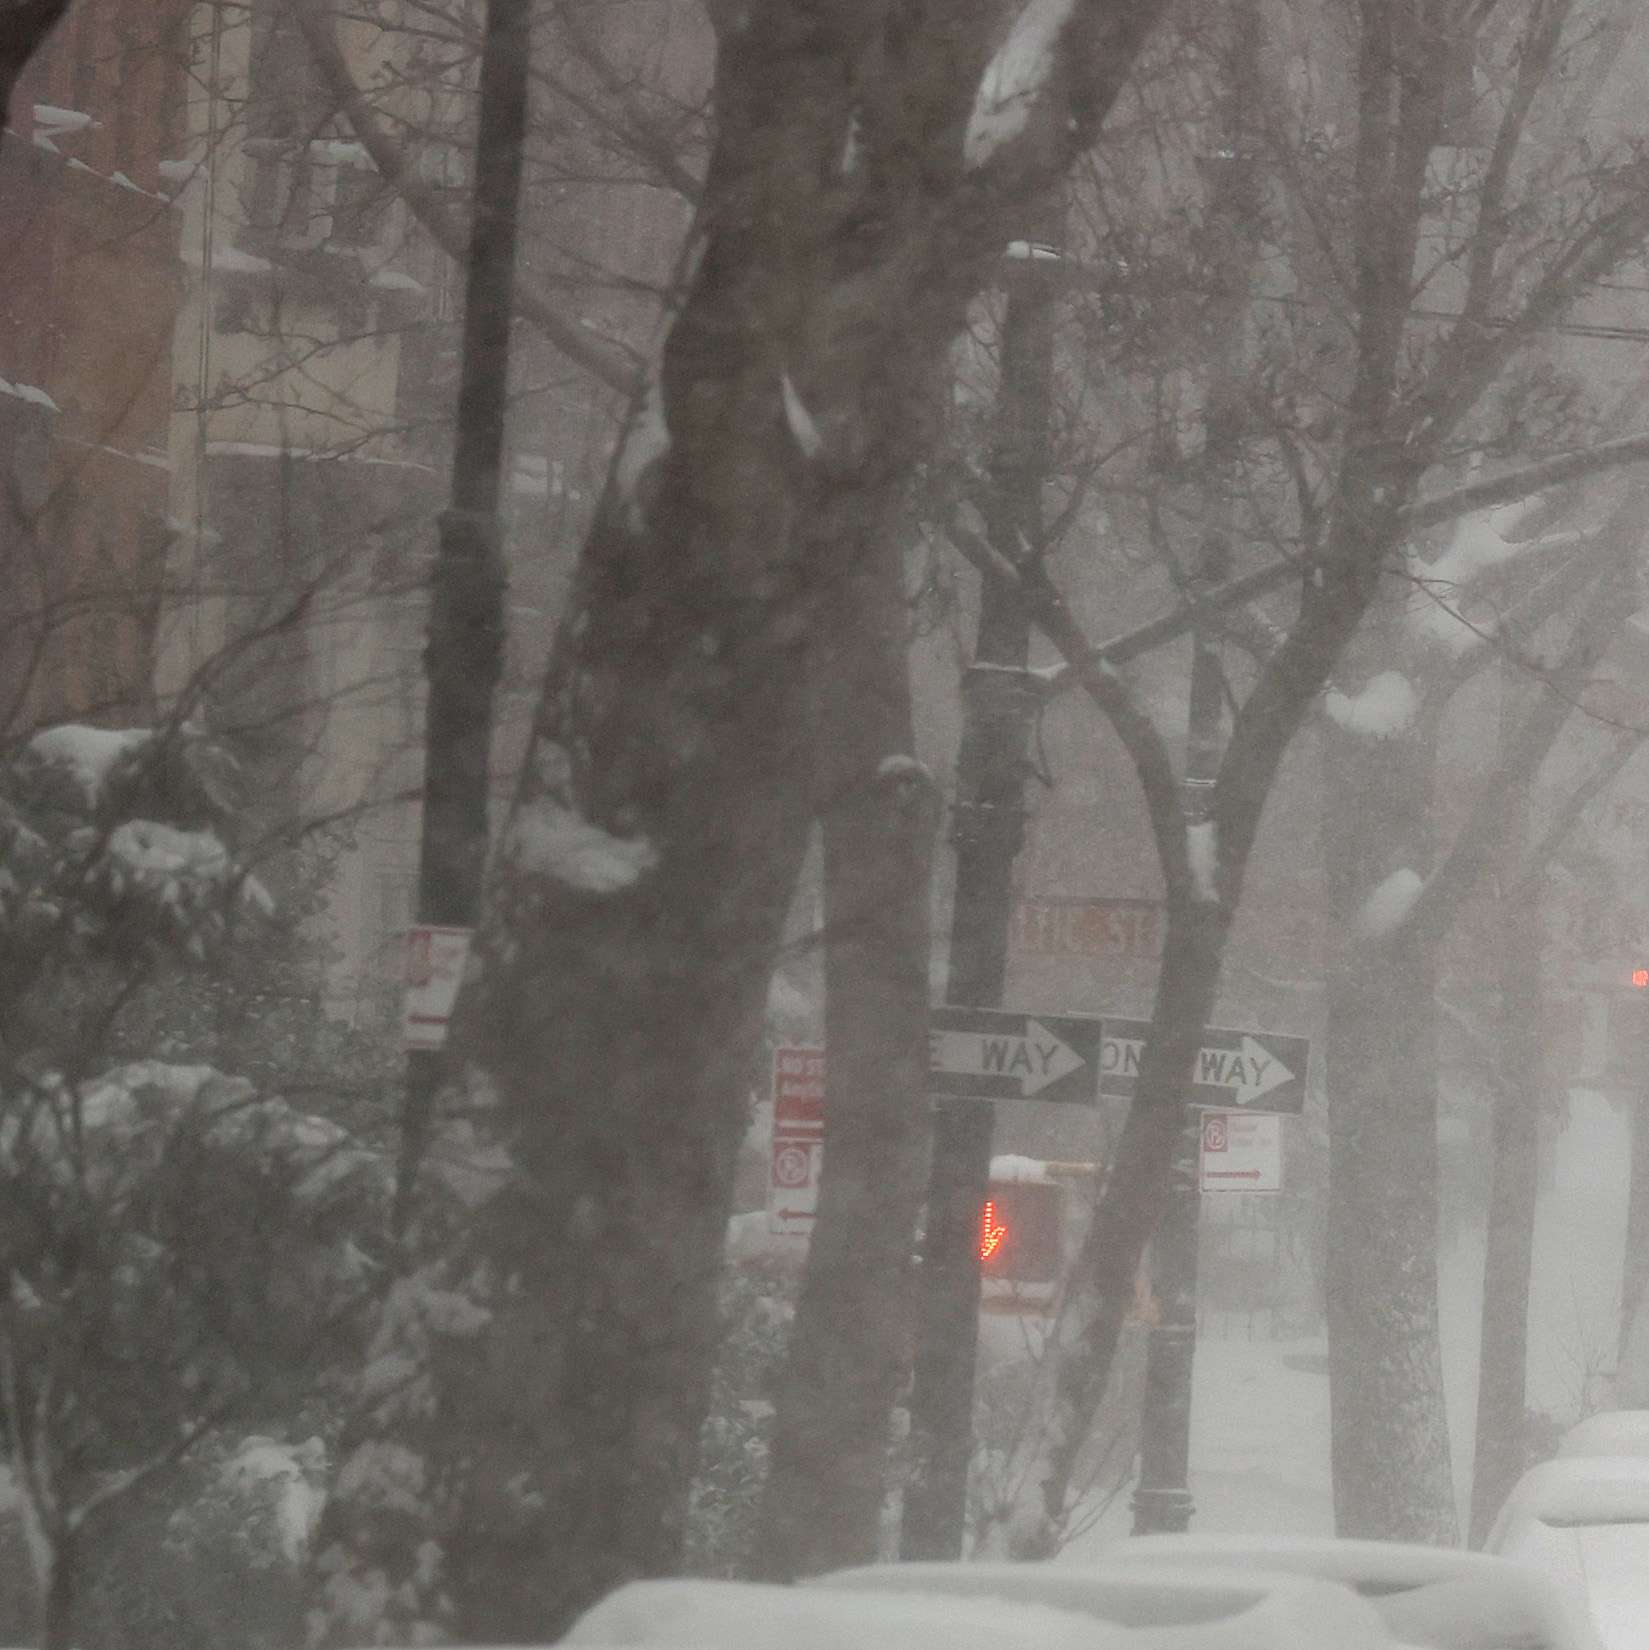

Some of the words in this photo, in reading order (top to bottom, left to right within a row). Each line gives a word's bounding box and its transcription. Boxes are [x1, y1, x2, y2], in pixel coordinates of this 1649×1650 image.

[982, 1039, 1059, 1075] WAY
[1102, 1041, 1141, 1073] ON
[1202, 1052, 1271, 1086] WAY
